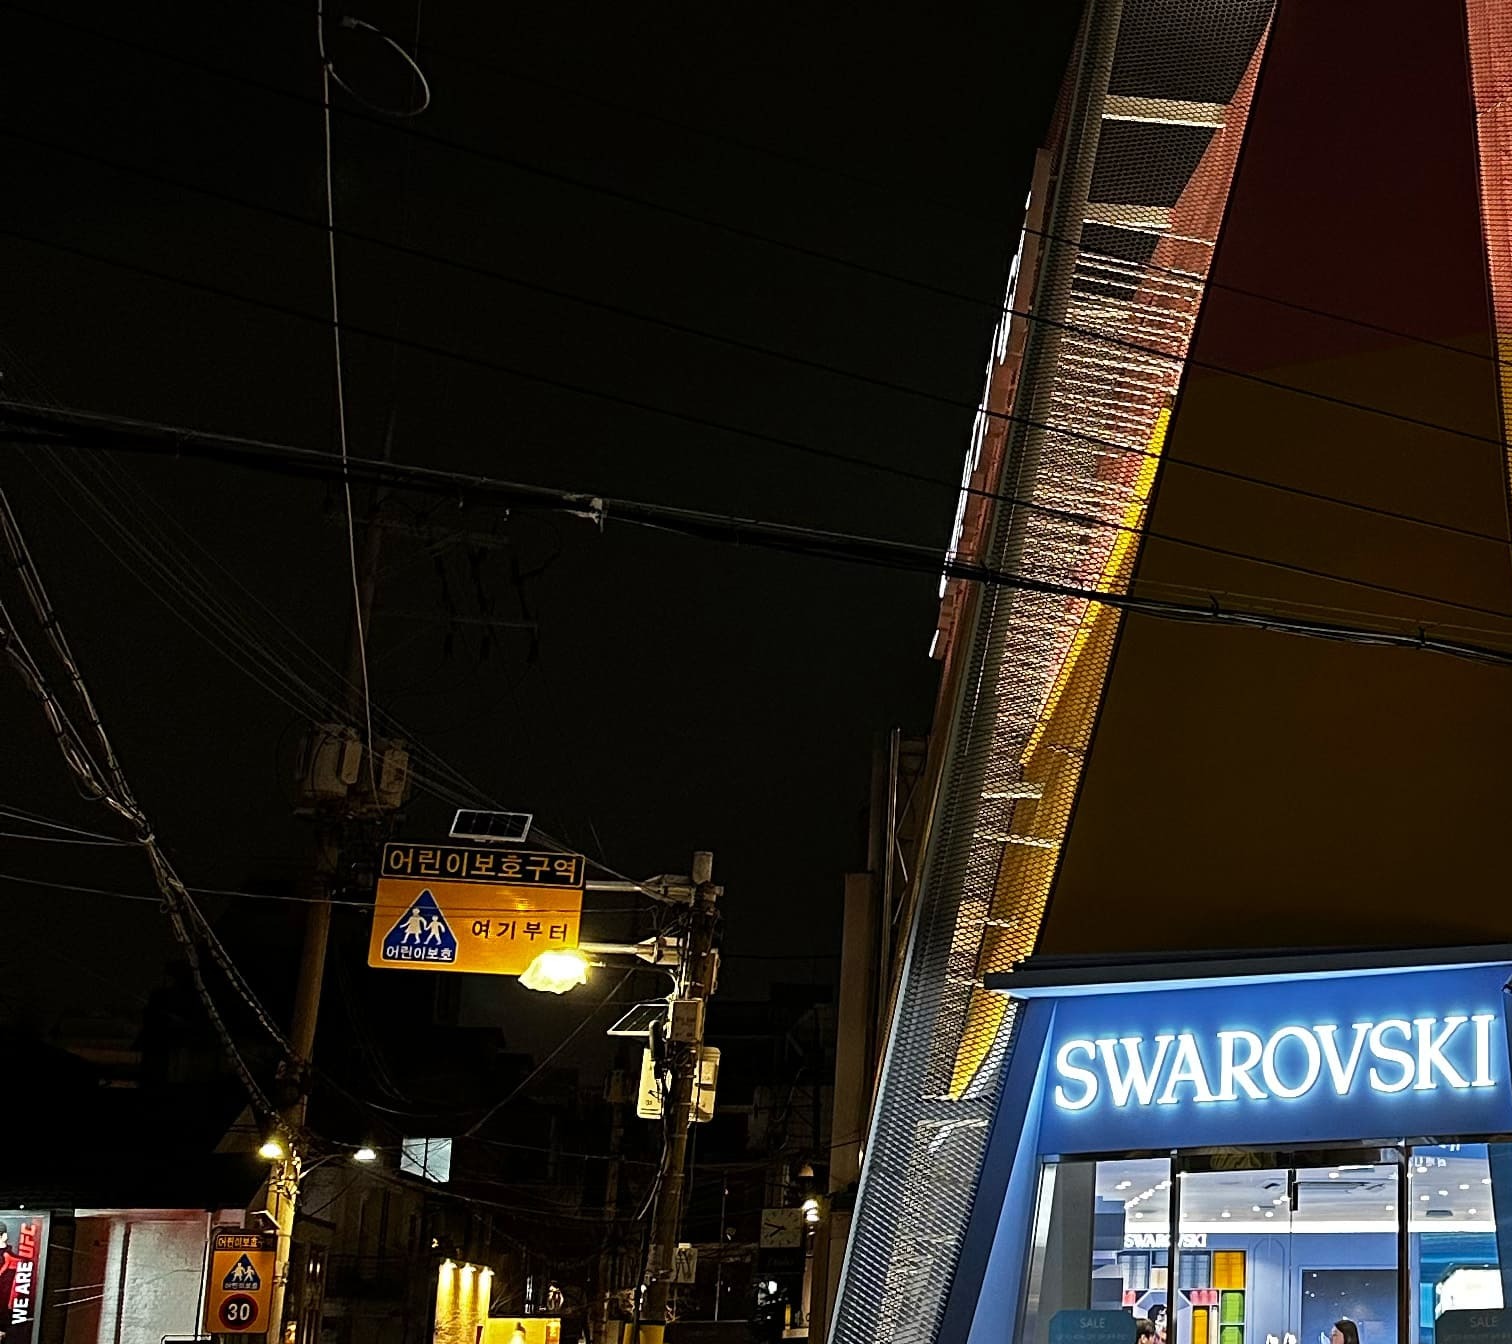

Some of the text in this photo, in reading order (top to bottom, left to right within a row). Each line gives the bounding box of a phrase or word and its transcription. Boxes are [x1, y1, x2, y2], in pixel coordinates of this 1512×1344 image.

[389, 849, 577, 883] 어린이보호구역
[471, 919, 569, 942] 여기부터
[386, 945, 453, 961] 어린이보호
[1055, 1014, 1497, 1110] SWAROVSKI
[11, 1222, 36, 1325] WE ARE UFC
[227, 1303, 250, 1321] 30
[1469, 1316, 1499, 1328] SALE
[1080, 1318, 1105, 1329] SALE
